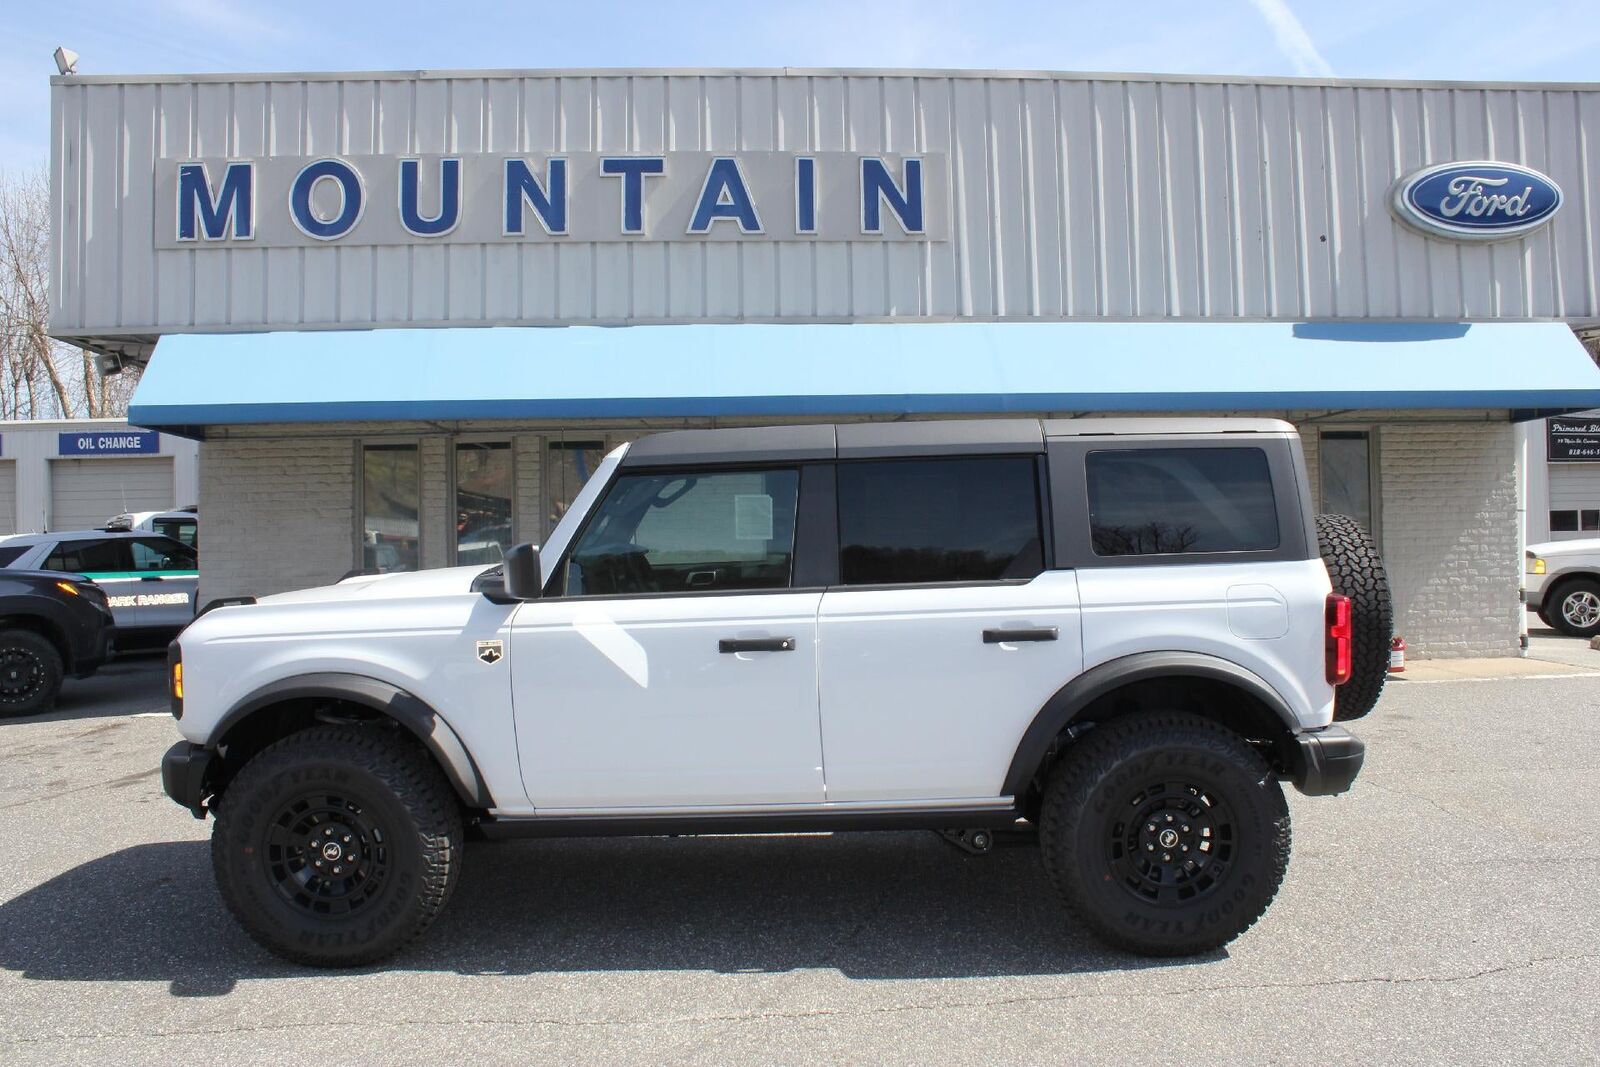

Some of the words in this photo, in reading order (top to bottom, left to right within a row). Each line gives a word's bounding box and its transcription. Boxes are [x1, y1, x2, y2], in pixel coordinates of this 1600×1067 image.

[176, 154, 927, 243] MOUNTAIN
[1439, 176, 1533, 217] Ford
[78, 437, 95, 449] OIL
[98, 436, 141, 449] CHANGE
[137, 592, 189, 606] RANGER
